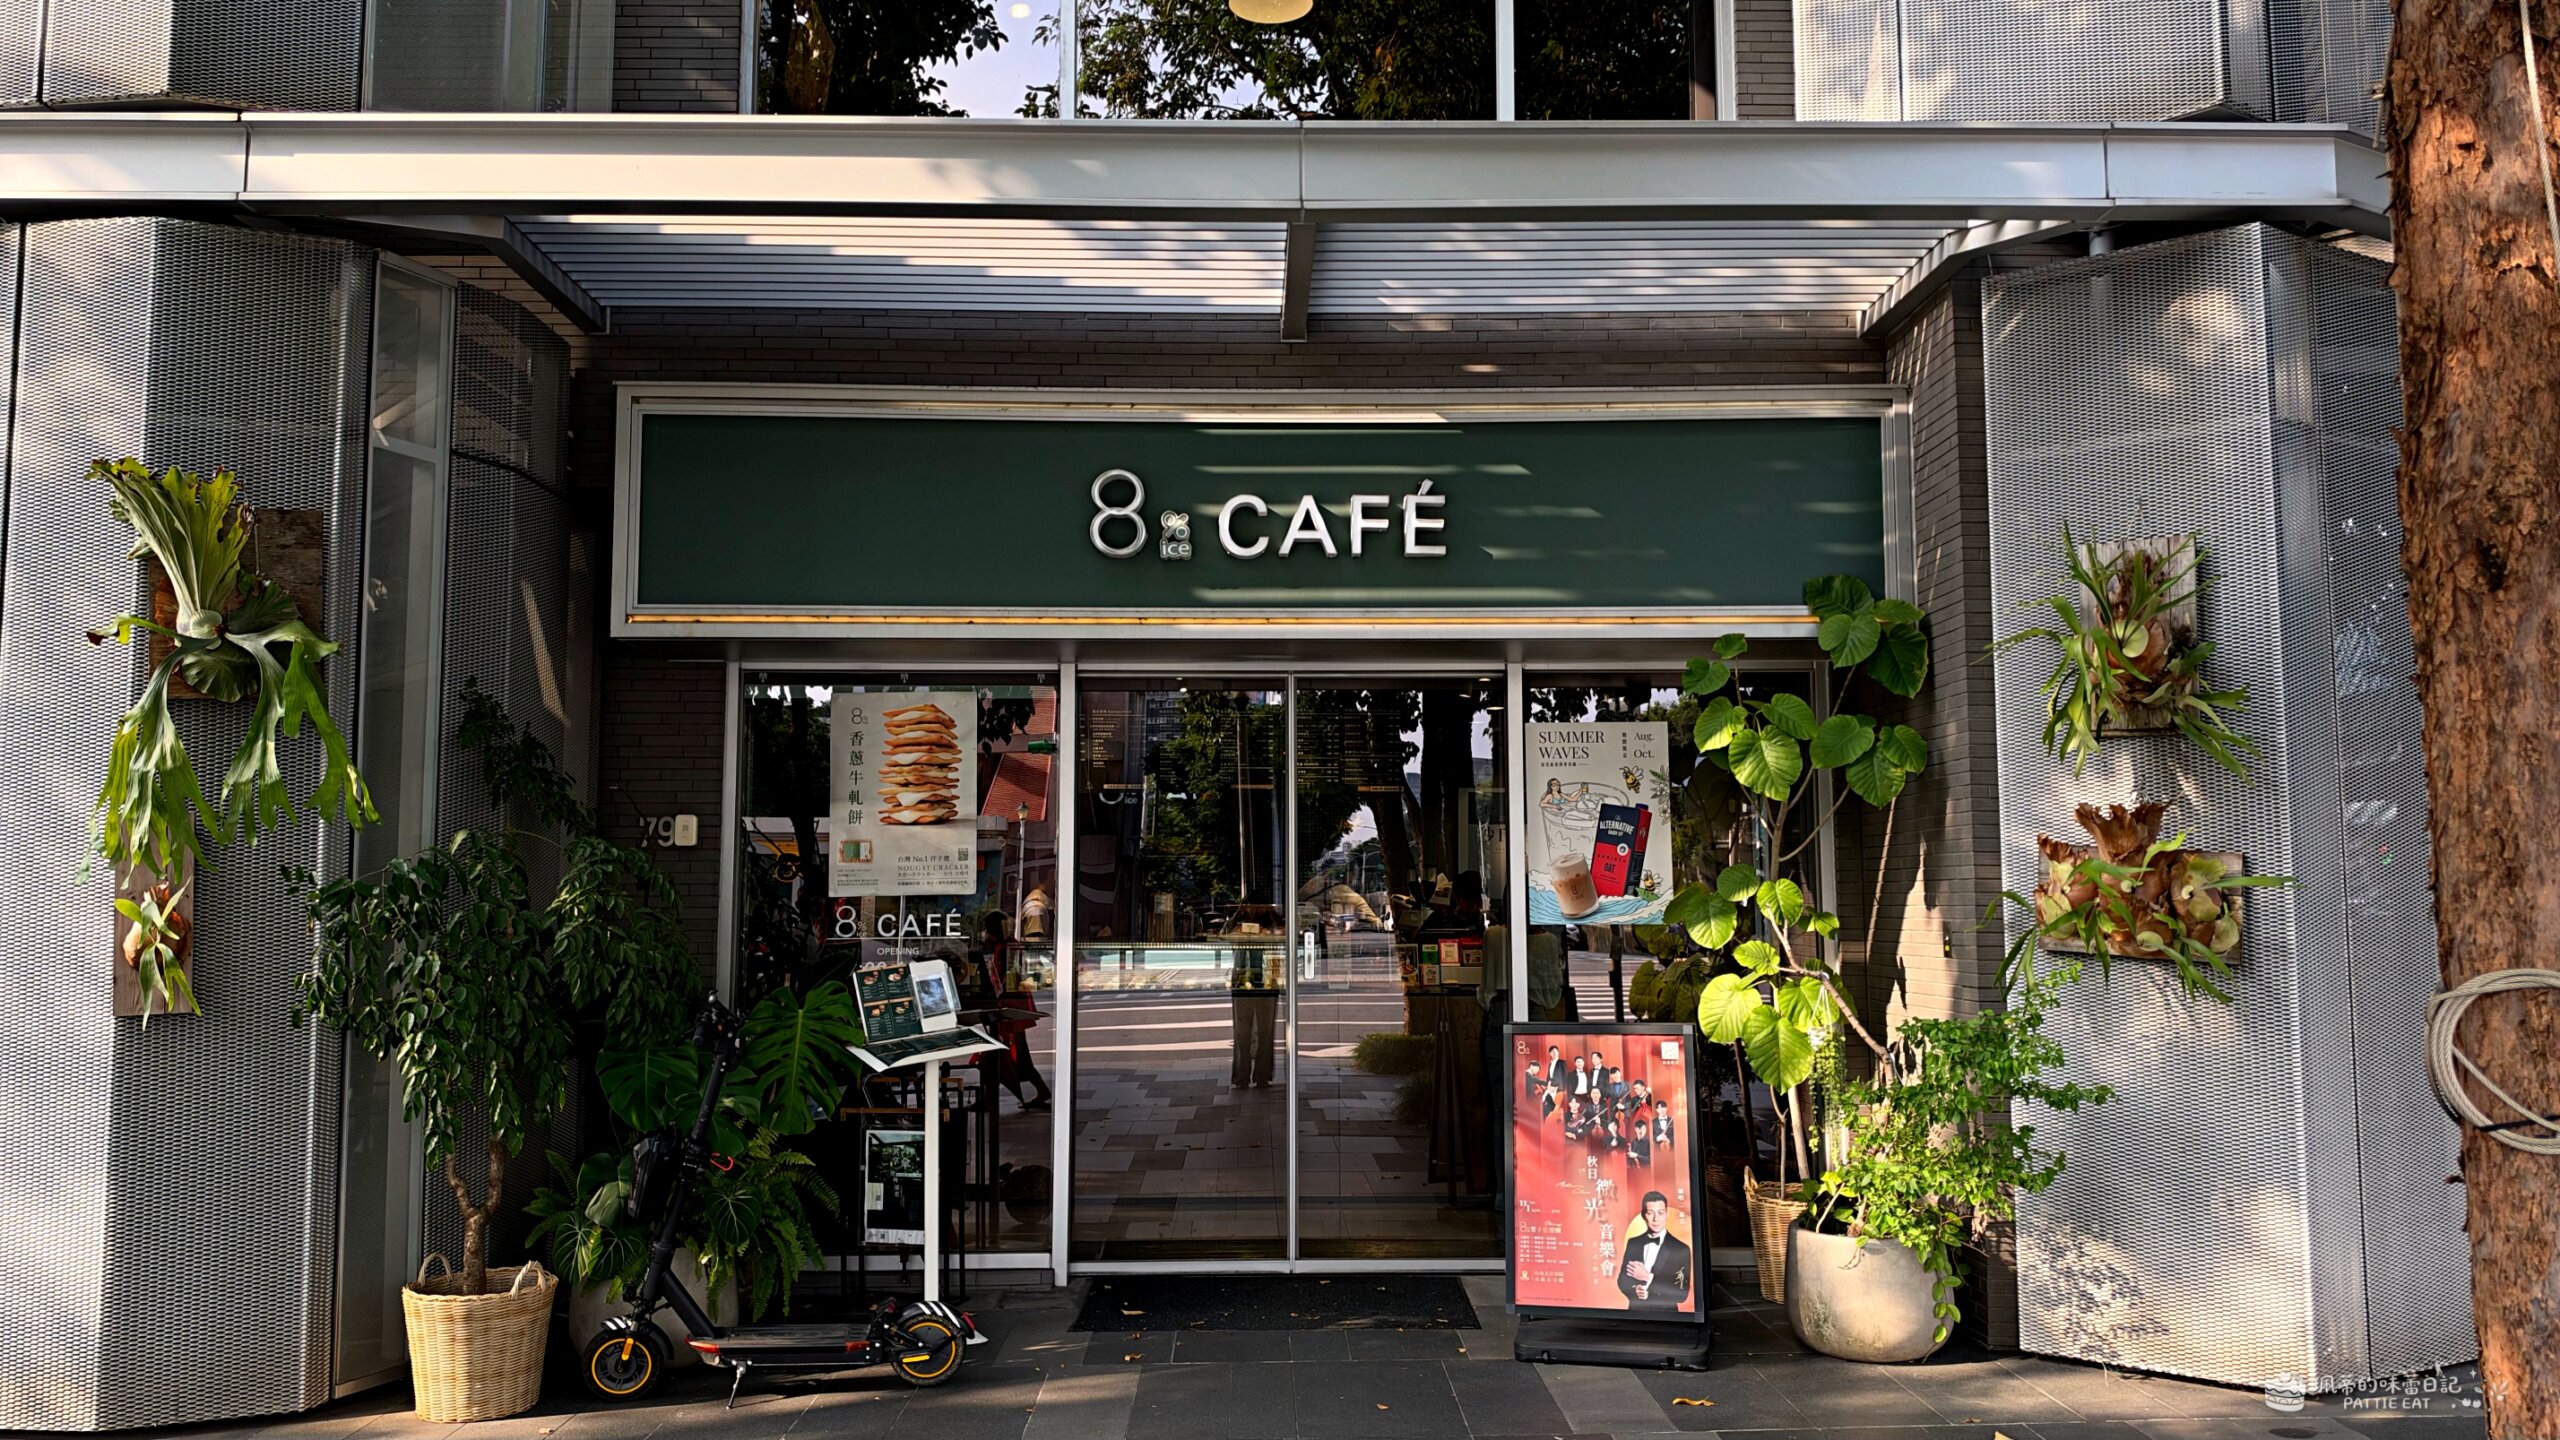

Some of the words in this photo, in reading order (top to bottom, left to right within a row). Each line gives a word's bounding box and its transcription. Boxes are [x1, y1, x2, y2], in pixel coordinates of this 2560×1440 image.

[1218, 478, 1447, 560] CAFÉ
[1538, 730, 1606, 744] SUMMER
[1633, 732, 1655, 742] Aug.
[1538, 746, 1590, 760] WAVES
[1633, 749, 1655, 759] Oct.
[1599, 820, 1635, 835] ALTERNATIVE
[1603, 863, 1616, 873] OAT
[877, 908, 962, 938] CAFÉ
[876, 947, 920, 956] OPENING
